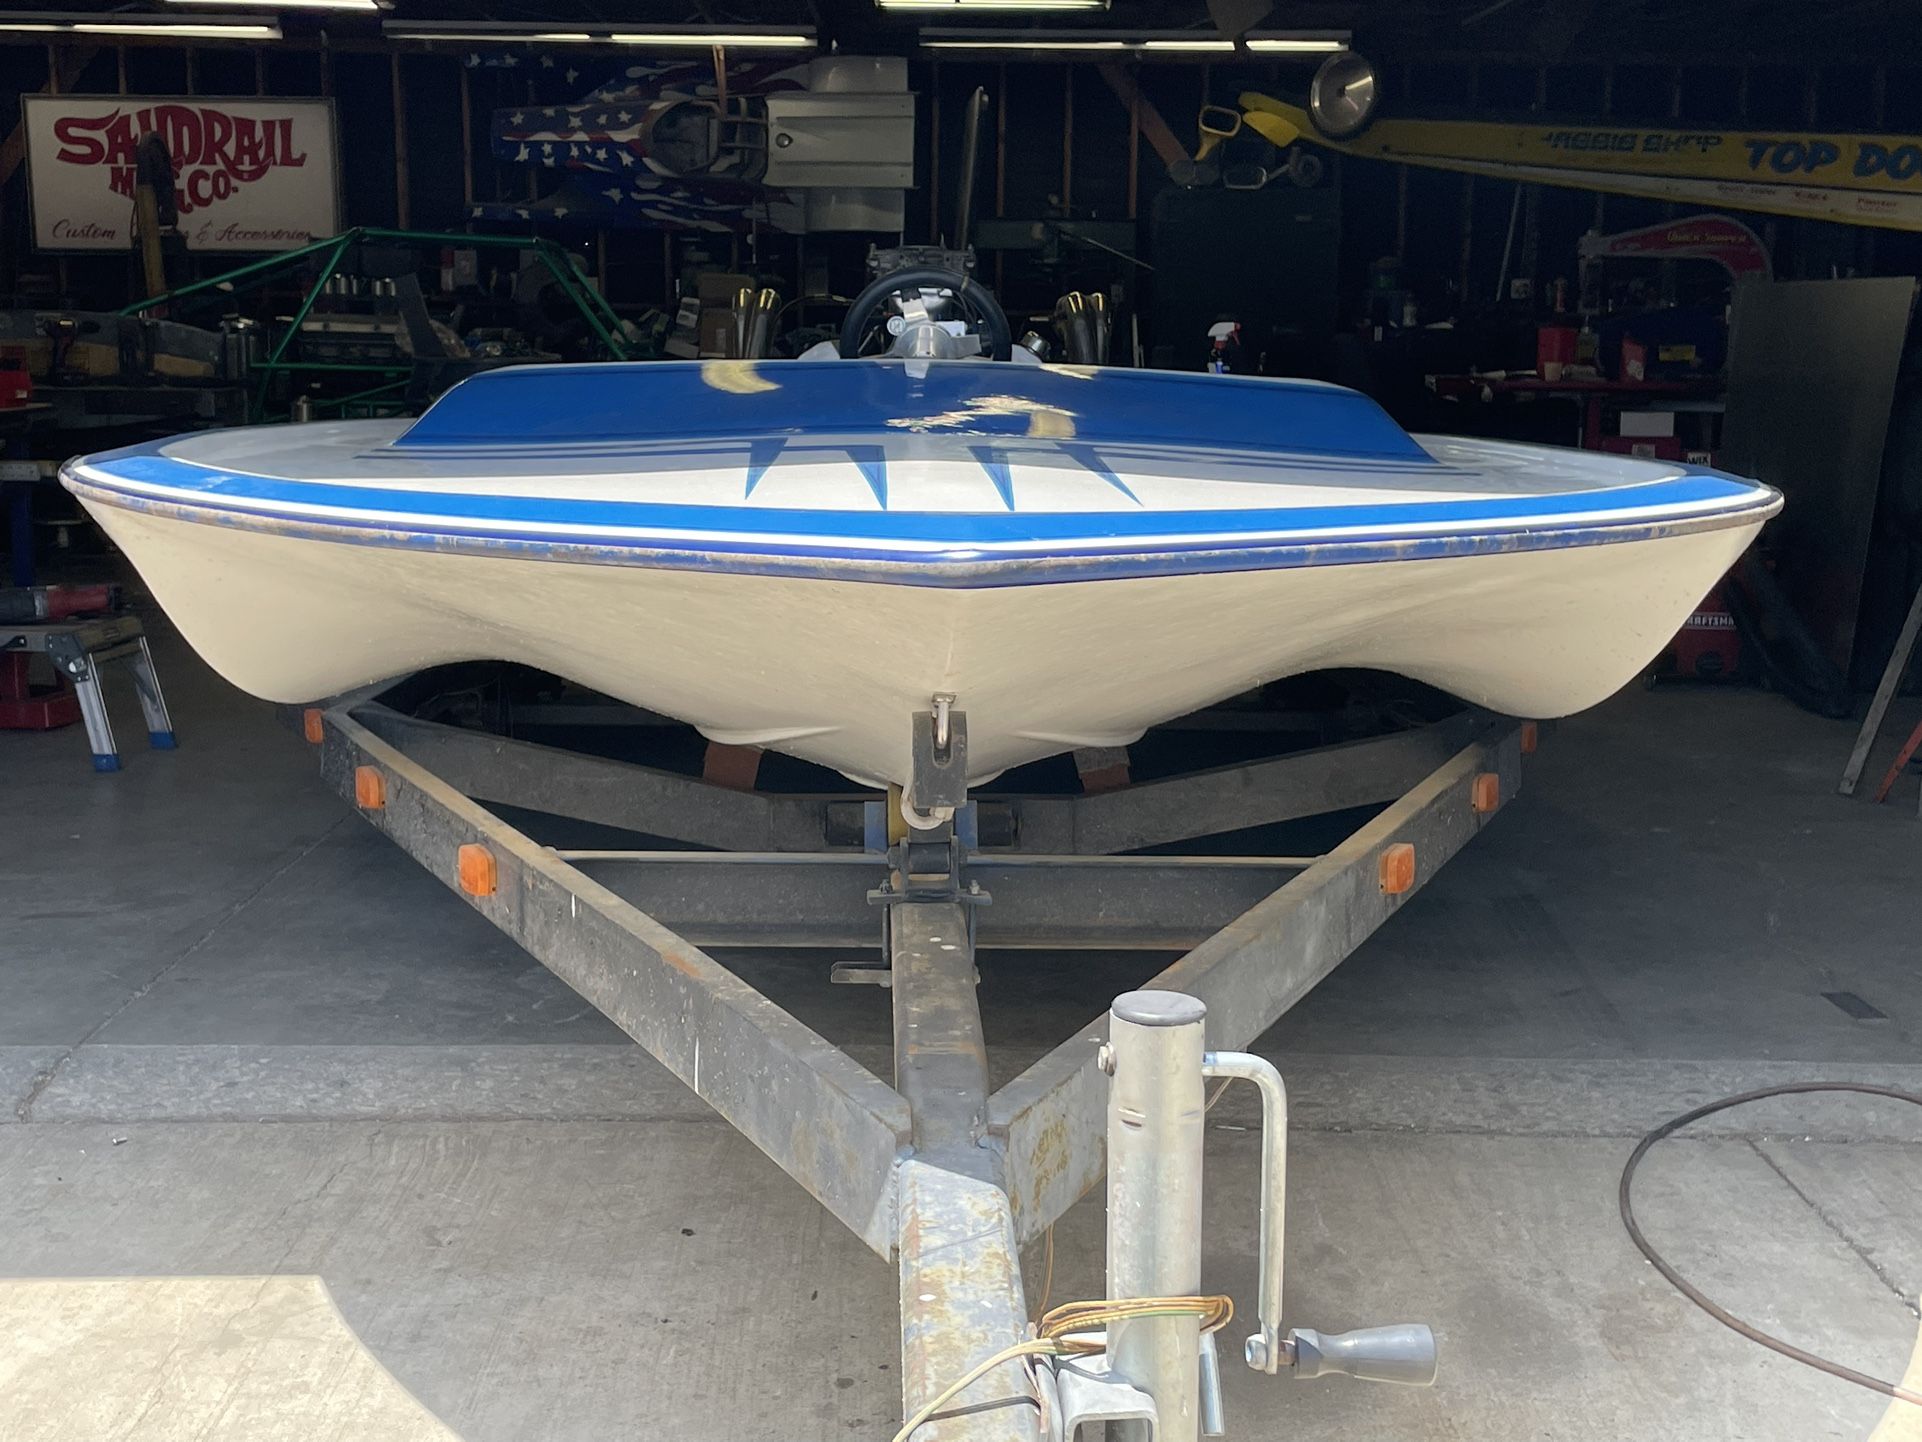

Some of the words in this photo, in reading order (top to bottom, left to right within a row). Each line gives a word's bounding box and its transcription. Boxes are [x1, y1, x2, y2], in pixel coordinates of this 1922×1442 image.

[1745, 139, 1841, 173] TOP
[1853, 143, 1922, 180] DO
[52, 219, 117, 241] Custom
[1686, 616, 1735, 626] RAFTSMA
